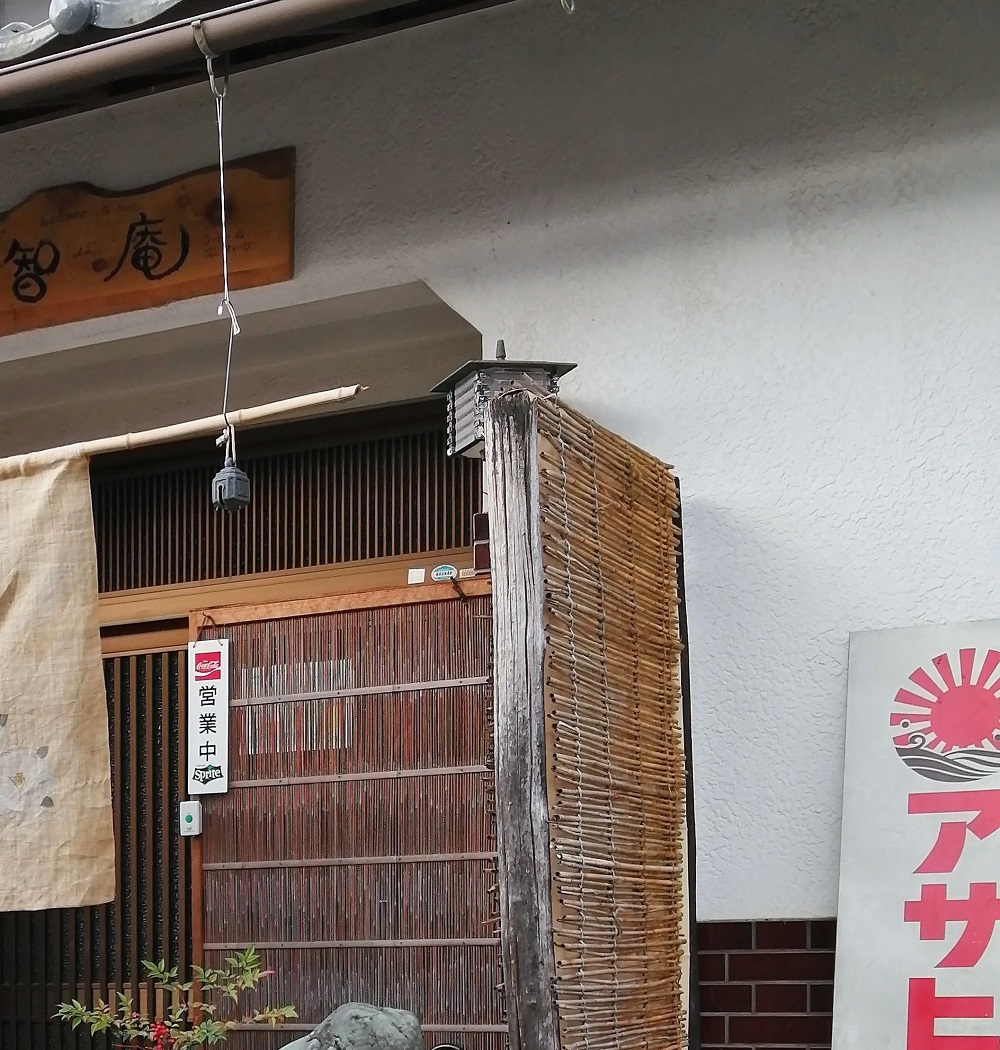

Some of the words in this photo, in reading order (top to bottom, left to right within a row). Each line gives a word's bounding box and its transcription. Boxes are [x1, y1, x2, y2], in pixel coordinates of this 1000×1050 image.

[198, 685, 218, 762] 営業中
[194, 768, 221, 782] Sprite
